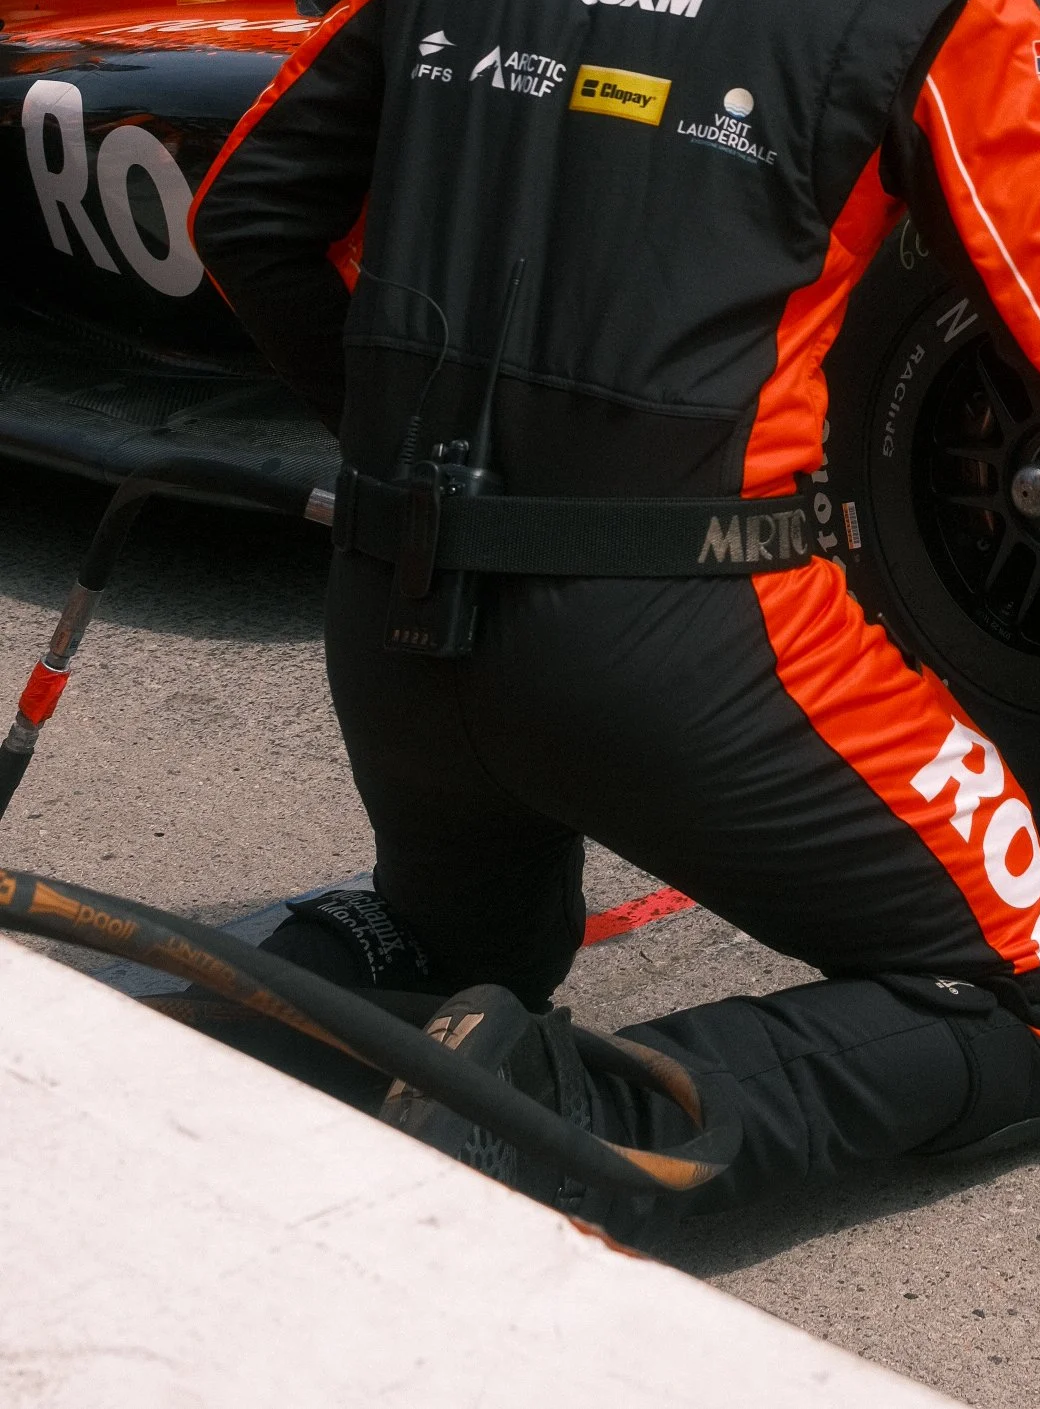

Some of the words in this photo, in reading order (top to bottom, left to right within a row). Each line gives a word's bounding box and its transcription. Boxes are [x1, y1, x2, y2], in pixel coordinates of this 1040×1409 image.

[504, 51, 566, 82] ARCTIC
[510, 72, 555, 98] WOLF
[600, 82, 652, 108] Clopay
[714, 113, 752, 137] VISIT
[677, 120, 777, 165] LAUDERDALE
[21, 79, 205, 298] RO
